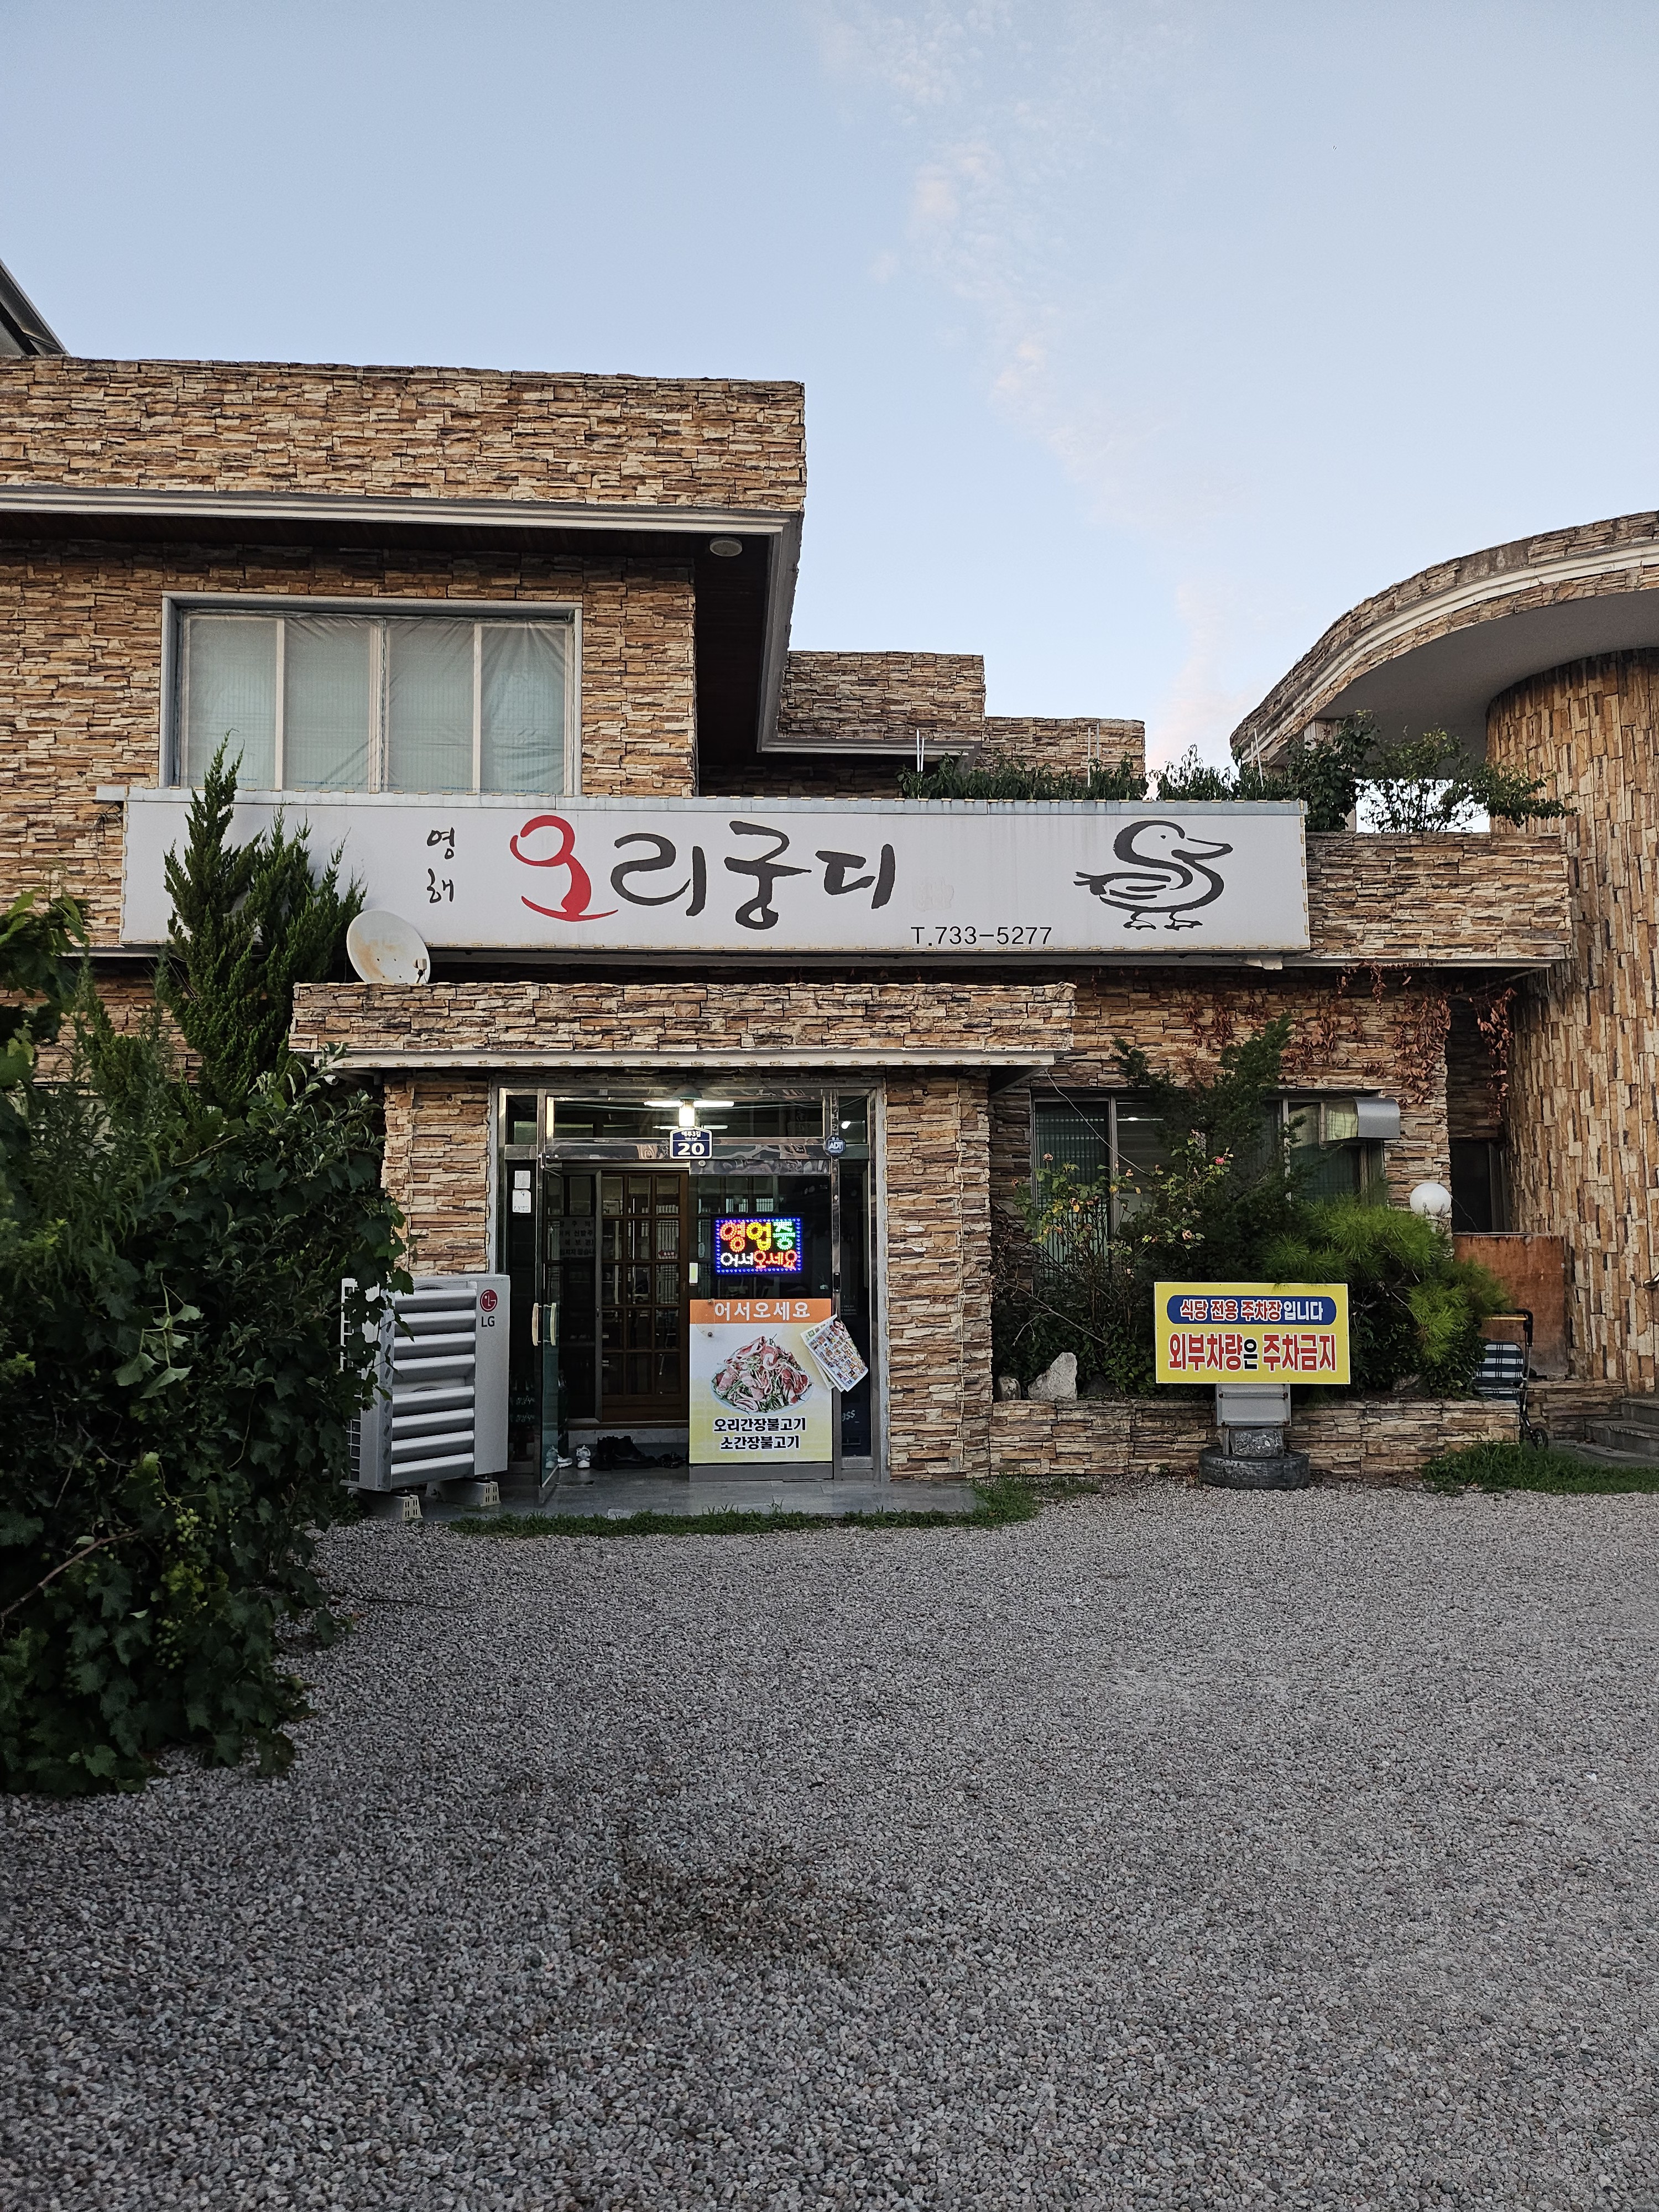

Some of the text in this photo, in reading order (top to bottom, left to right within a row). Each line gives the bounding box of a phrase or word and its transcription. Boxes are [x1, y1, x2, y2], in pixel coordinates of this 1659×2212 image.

[427, 827, 455, 904] 영해
[910, 926, 1053, 947] T.733-5277
[677, 1142, 705, 1156] 20
[829, 1141, 843, 1150] ADT
[719, 1221, 796, 1253] 영업중
[720, 1250, 797, 1270] 어서오세요
[713, 1301, 811, 1321] 어서오세요
[1180, 1299, 1208, 1321] 식당
[1211, 1299, 1238, 1321] 전용
[481, 1316, 495, 1328] LG
[1169, 1333, 1336, 1371] 외부차량은 주차금지
[714, 1417, 806, 1432] 오리간장불고기
[721, 1436, 800, 1450] 소간장불고기
